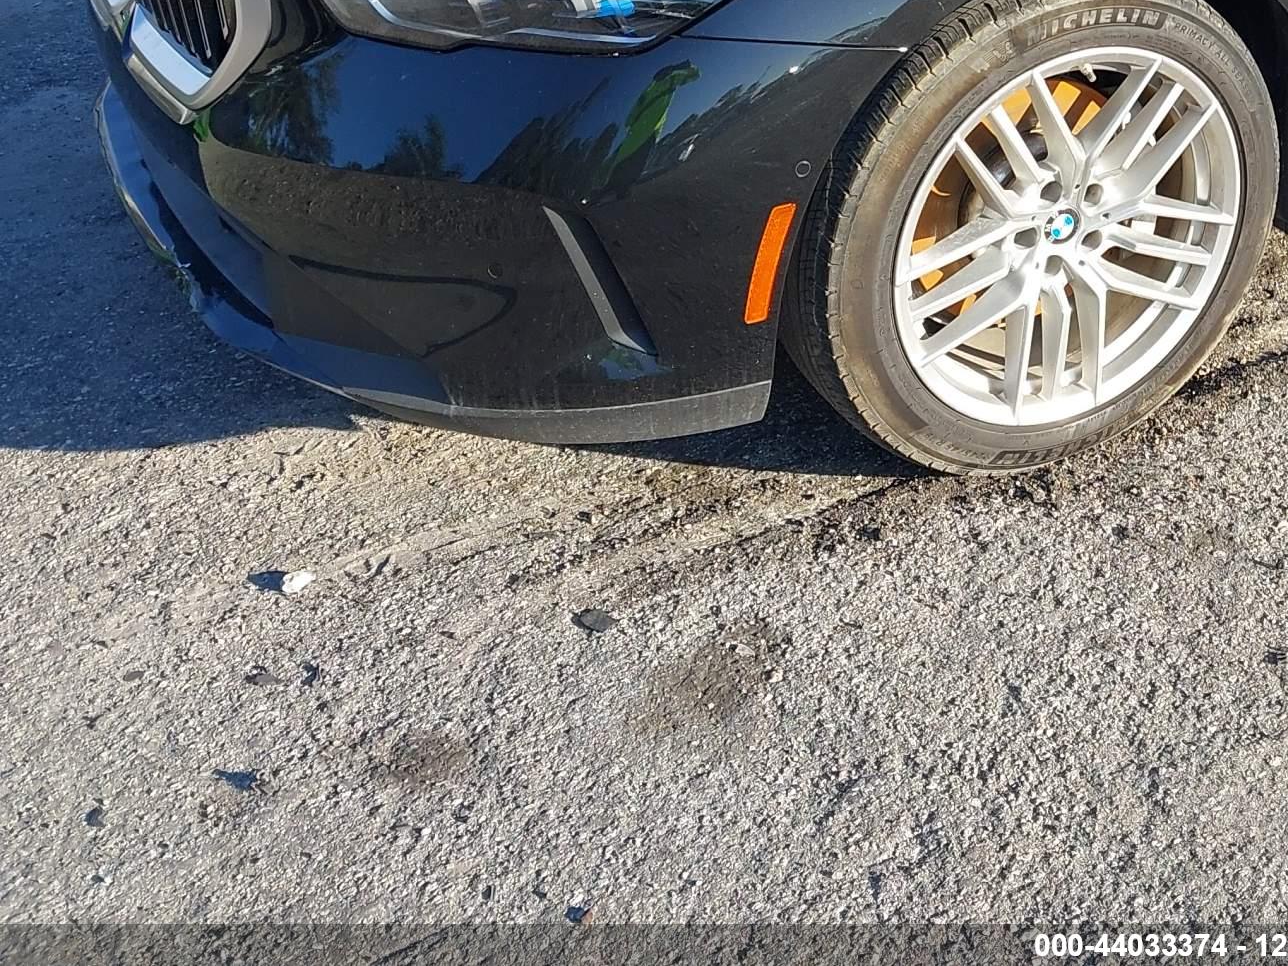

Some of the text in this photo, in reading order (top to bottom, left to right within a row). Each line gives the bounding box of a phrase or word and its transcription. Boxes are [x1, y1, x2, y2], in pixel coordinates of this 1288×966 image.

[1026, 7, 1161, 47] MICHELIN
[1174, 22, 1215, 50] PRIMACY
[1216, 50, 1230, 67] ALL
